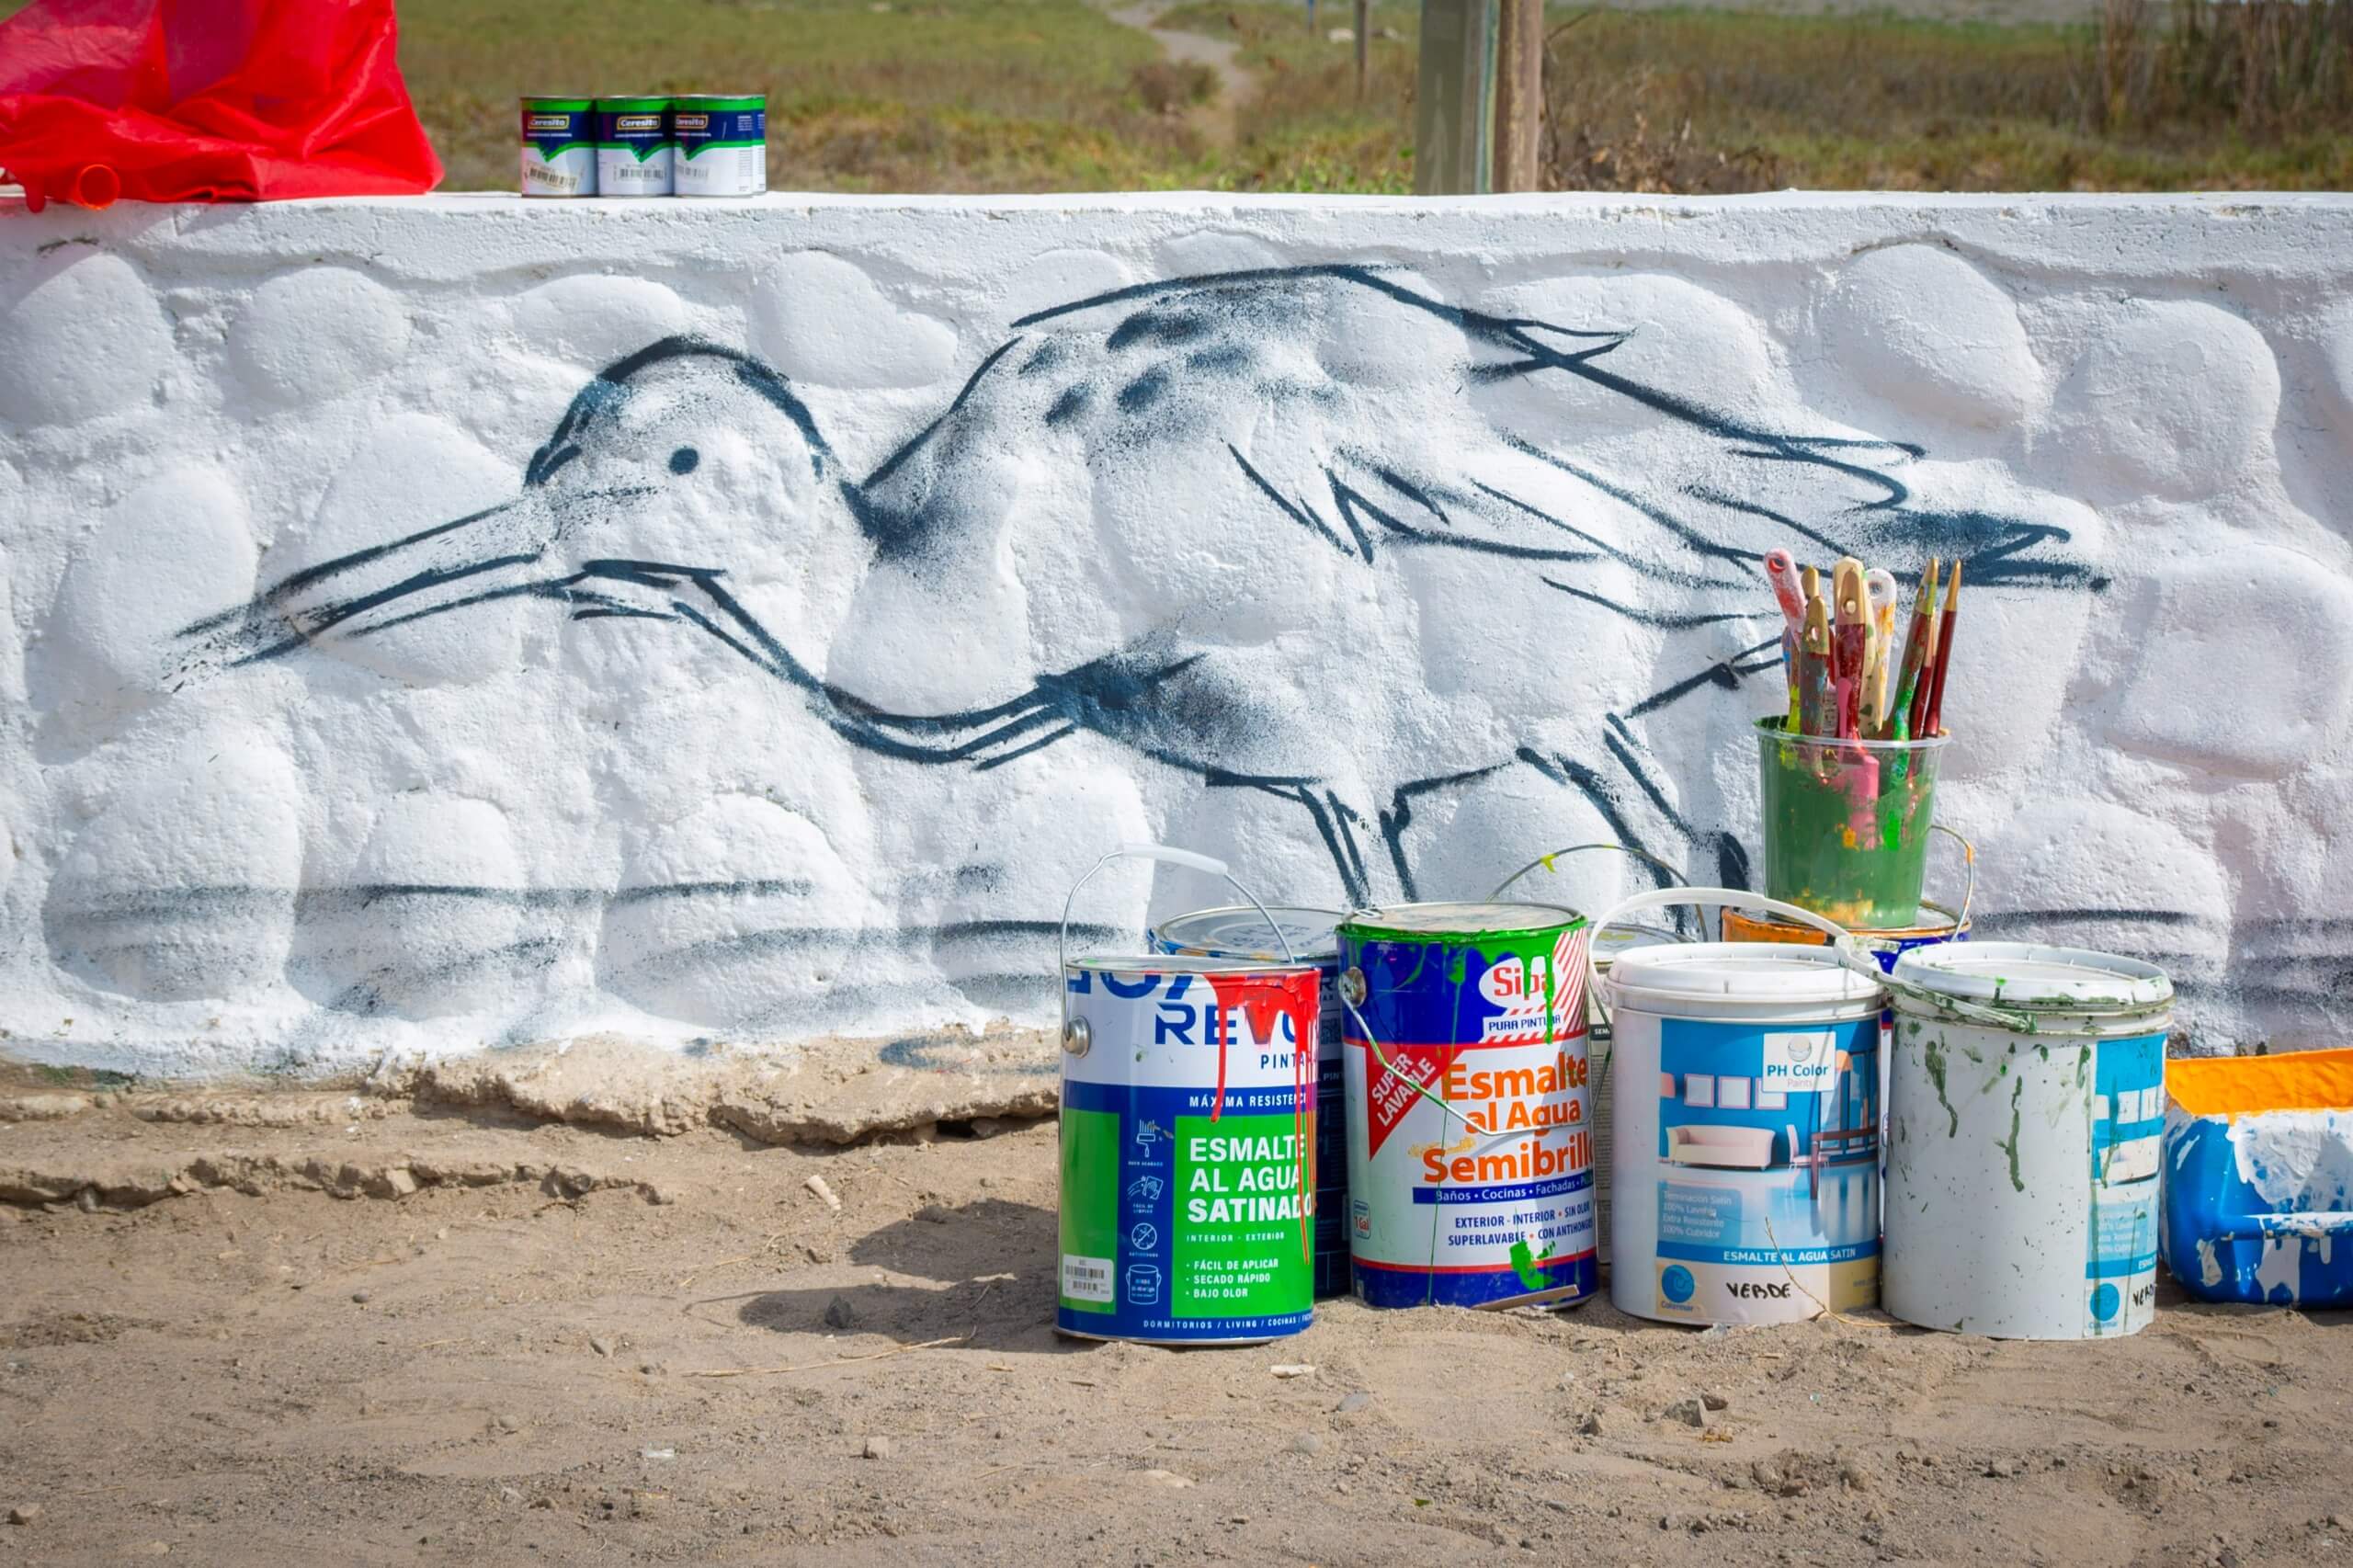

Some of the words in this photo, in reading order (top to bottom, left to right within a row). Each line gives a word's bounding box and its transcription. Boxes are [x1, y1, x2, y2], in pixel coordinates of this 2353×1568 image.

[1489, 1019, 1518, 1031] PURA
[1371, 1052, 1414, 1105] SUPER
[1441, 1051, 1587, 1101] Esmalte
[1767, 1064, 1788, 1077] PH
[1792, 1062, 1829, 1077] Color
[1189, 1093, 1244, 1108] MÁXMA
[1464, 1101, 1498, 1133] al
[1506, 1099, 1581, 1138] Agua
[1189, 1133, 1305, 1162] ESMALTE
[1189, 1168, 1229, 1192] AL
[1436, 1188, 1471, 1202] Baños
[1481, 1187, 1527, 1200] Cocinas
[1535, 1178, 1576, 1195] Fachadas
[1188, 1192, 1313, 1222] SATINADO
[1455, 1215, 1505, 1229] EXTERIOR
[1513, 1210, 1555, 1225] INTERIOR
[1564, 1205, 1576, 1218] SIN
[1576, 1200, 1590, 1214] OLOR
[1187, 1234, 1233, 1243] INTERIOR
[1245, 1232, 1285, 1242] EXTERIOR
[1448, 1231, 1526, 1246] SUPERLAVABLE
[1538, 1227, 1555, 1240] CON
[1193, 1259, 1222, 1270] FÁCIL
[1226, 1260, 1239, 1270] DE
[1243, 1258, 1279, 1269] APLICAR
[1723, 1250, 1778, 1262] ESMALTE
[1780, 1251, 1795, 1262] AL
[1799, 1250, 1827, 1262] AGUA
[1193, 1274, 1233, 1284] SECADO
[1237, 1271, 1271, 1283] RÁPIDO
[1193, 1288, 1219, 1299] BAJO
[1222, 1288, 1248, 1298] OLOR
[1726, 1282, 1791, 1300] VERDE
[1143, 1319, 1212, 1330] DORMITORIOS
[1226, 1319, 1257, 1329] LIVING
[1267, 1315, 1297, 1326] COCINAS
